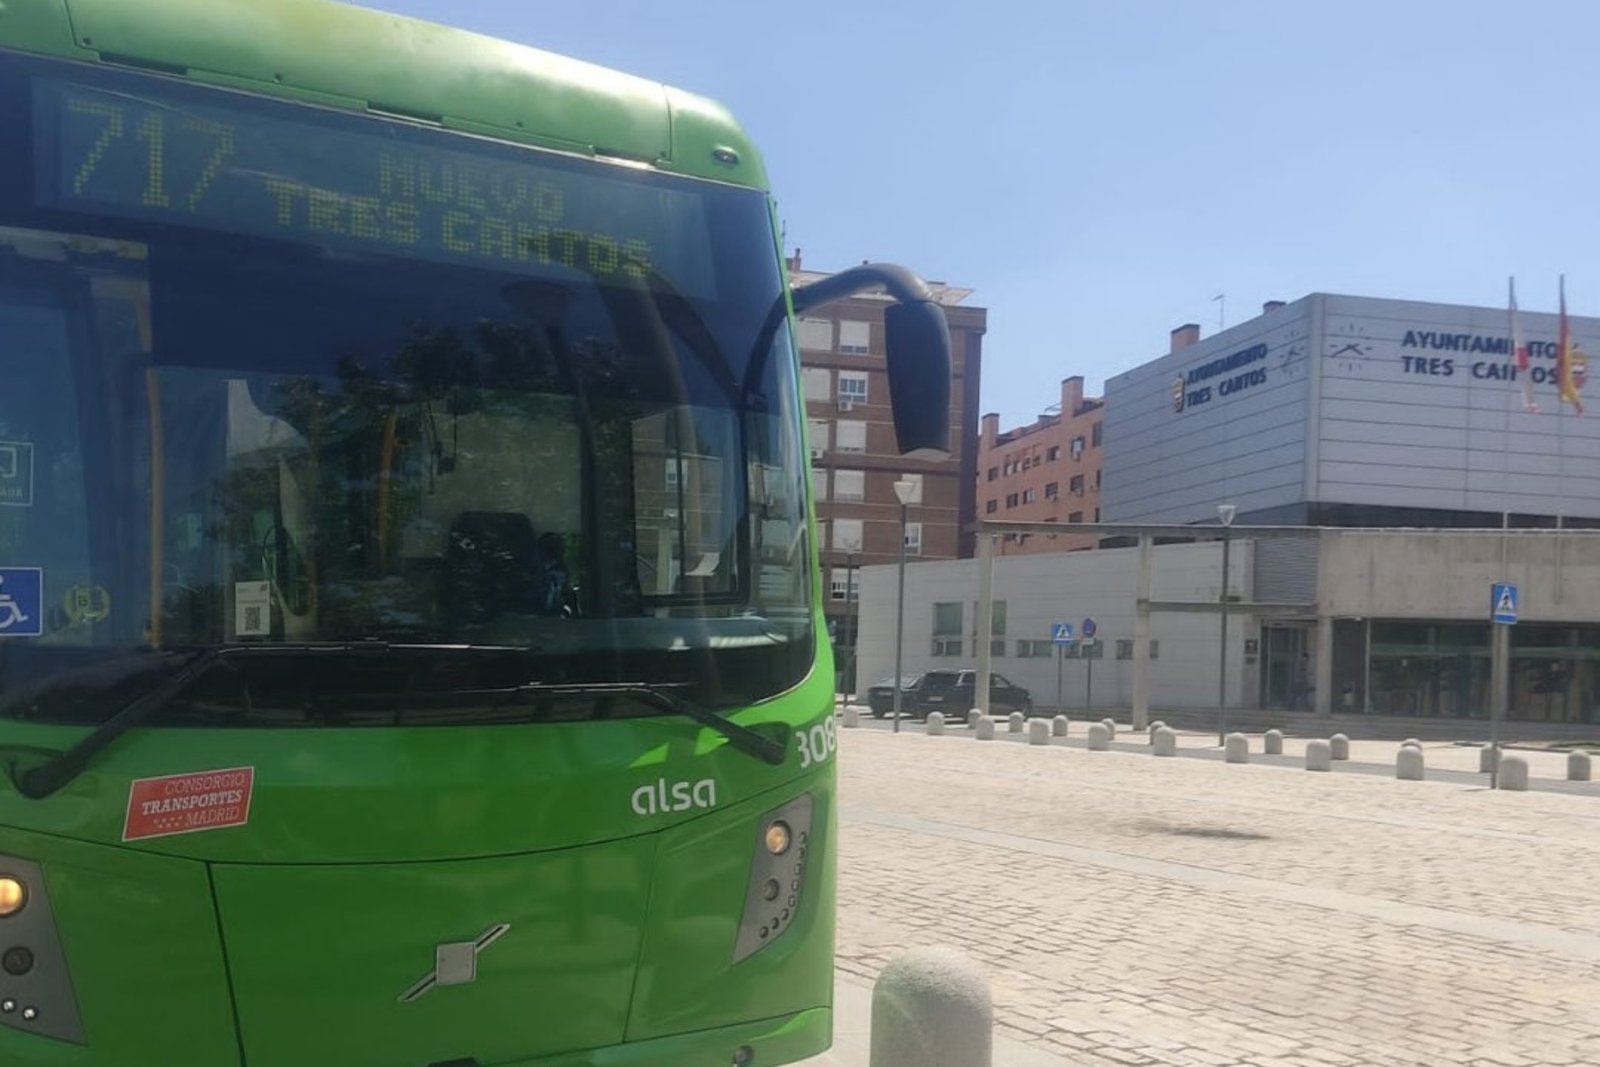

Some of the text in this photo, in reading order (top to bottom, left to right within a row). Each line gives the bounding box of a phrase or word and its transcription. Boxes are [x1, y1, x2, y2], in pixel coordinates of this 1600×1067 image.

[67, 98, 235, 213] 717
[379, 153, 563, 222] NUEVO
[264, 177, 651, 278] TRES CANTOS
[1402, 355, 1559, 385] TRES CANOS
[165, 773, 245, 795] CONSORCIO
[631, 778, 717, 815] alsa
[142, 789, 242, 815] TRANSPORTES
[185, 806, 240, 826] MADRID
